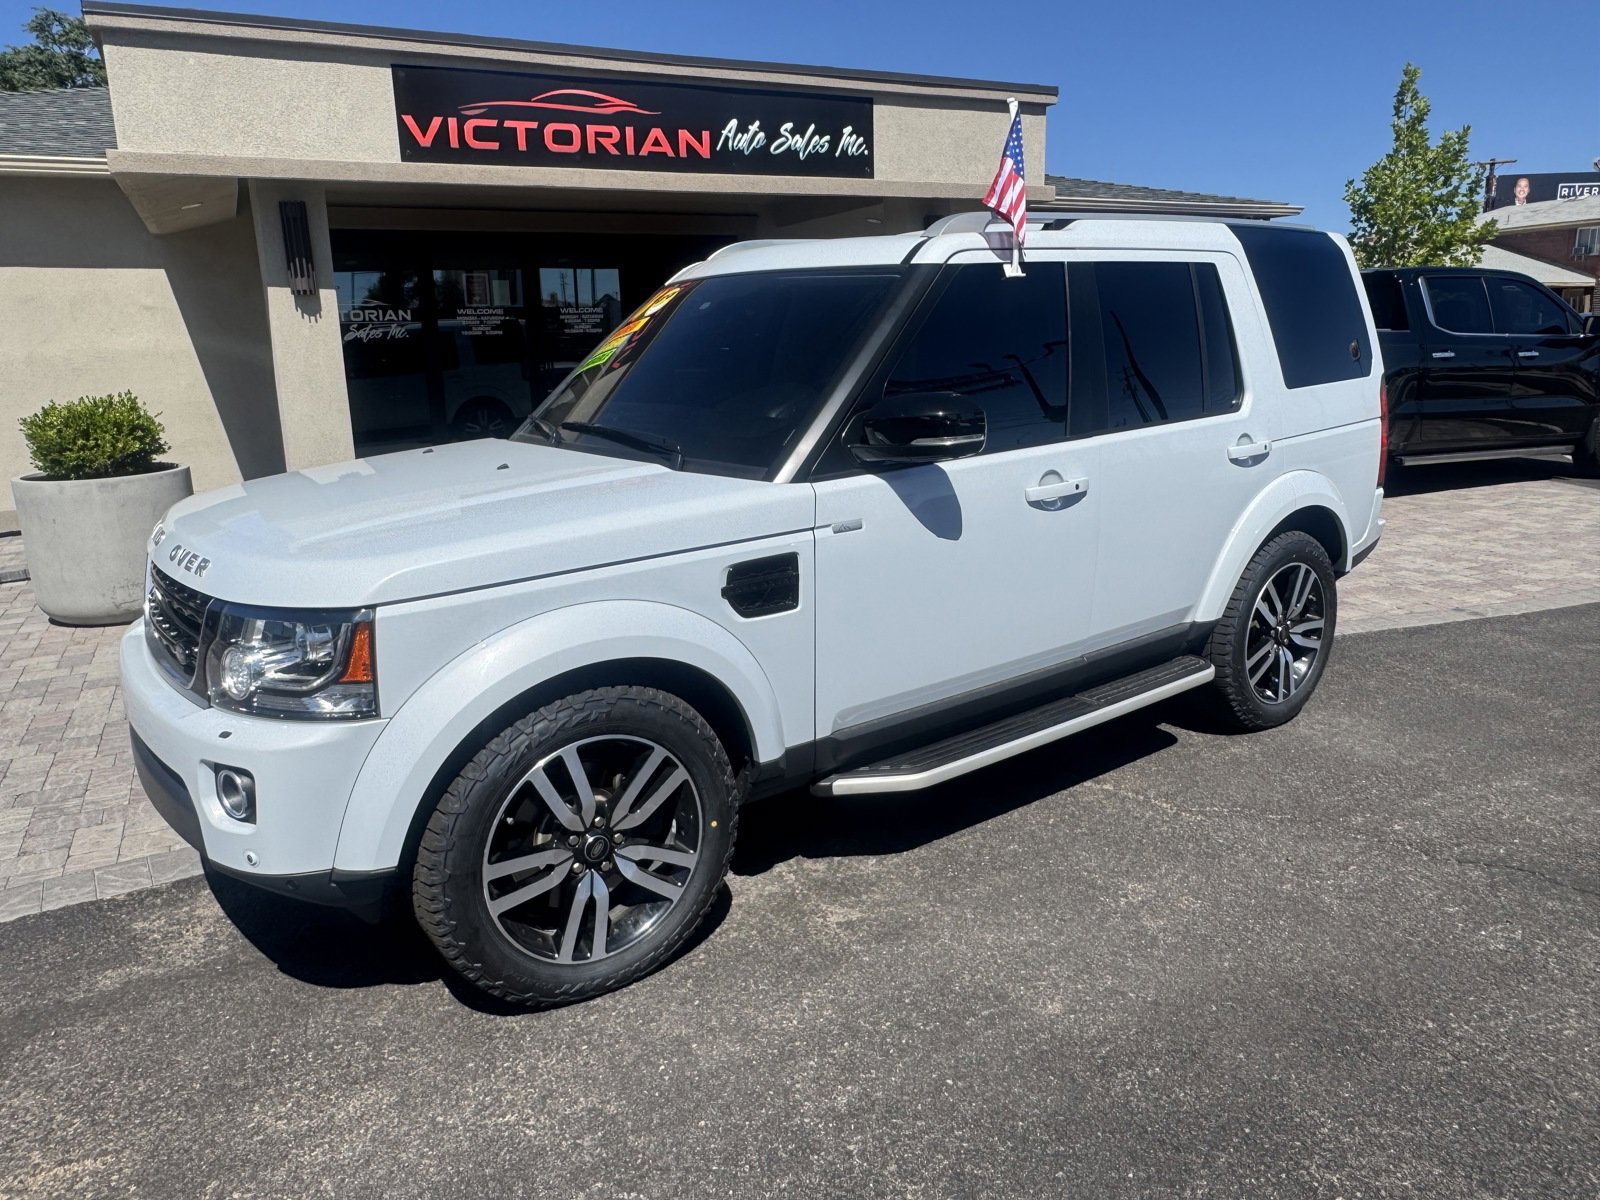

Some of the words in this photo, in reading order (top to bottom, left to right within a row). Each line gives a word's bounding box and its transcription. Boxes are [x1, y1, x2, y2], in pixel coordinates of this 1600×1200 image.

[400, 114, 711, 159] VICTORIAN
[716, 118, 768, 156] Auto
[769, 122, 831, 161] Sales
[835, 125, 869, 157] Inc.
[342, 323, 384, 343] Sales
